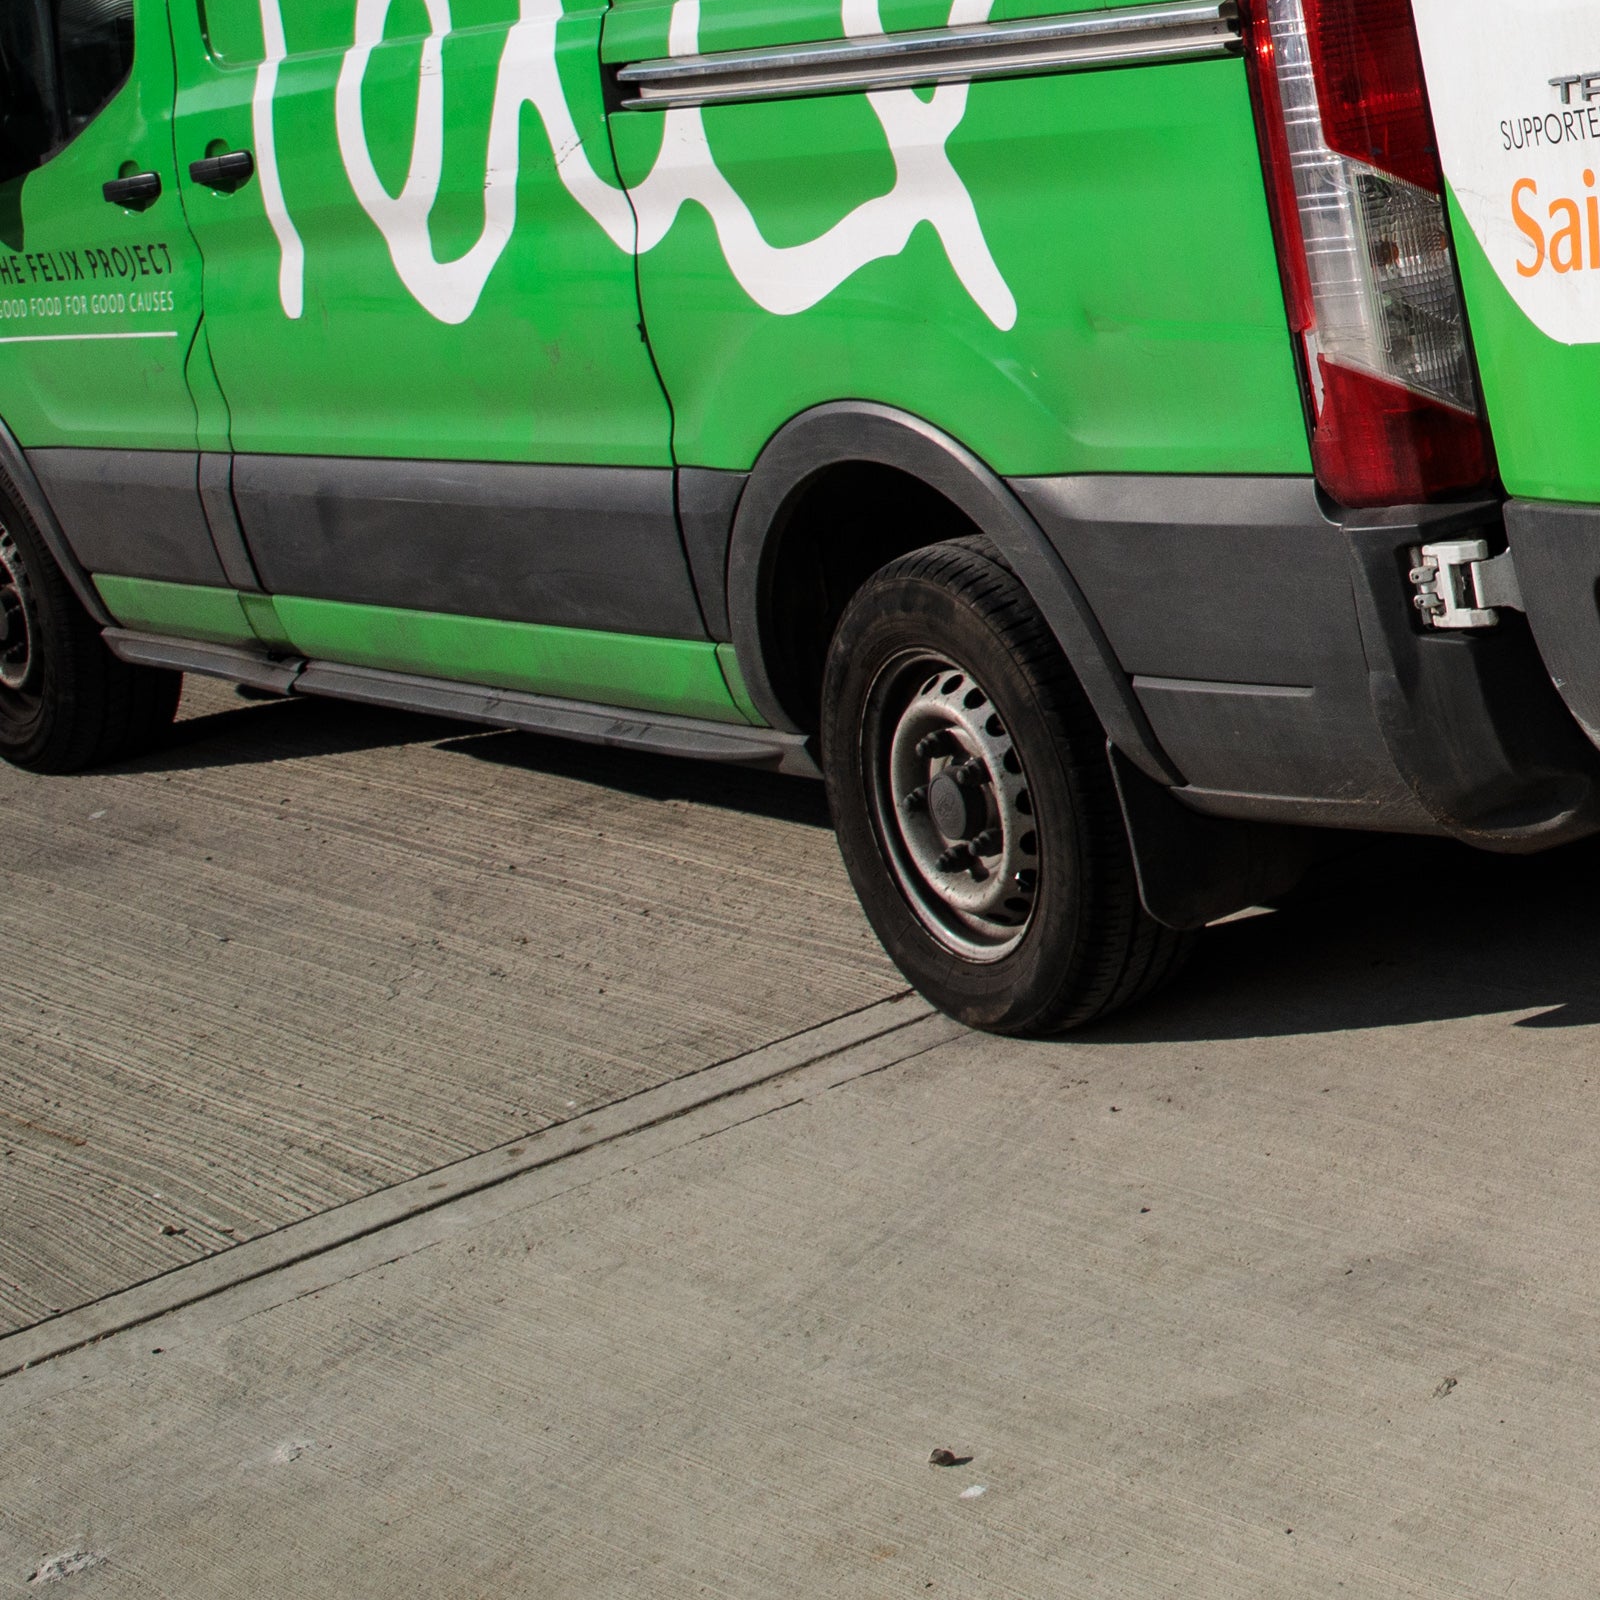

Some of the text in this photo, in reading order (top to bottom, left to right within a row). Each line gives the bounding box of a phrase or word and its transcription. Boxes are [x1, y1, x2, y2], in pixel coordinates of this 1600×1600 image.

[25, 251, 85, 283] FELIX
[85, 243, 172, 282] PROJECT
[31, 296, 62, 317] FOOD
[65, 295, 88, 316] FOR
[90, 293, 126, 314] GOOD
[129, 290, 174, 312] CAUSES
